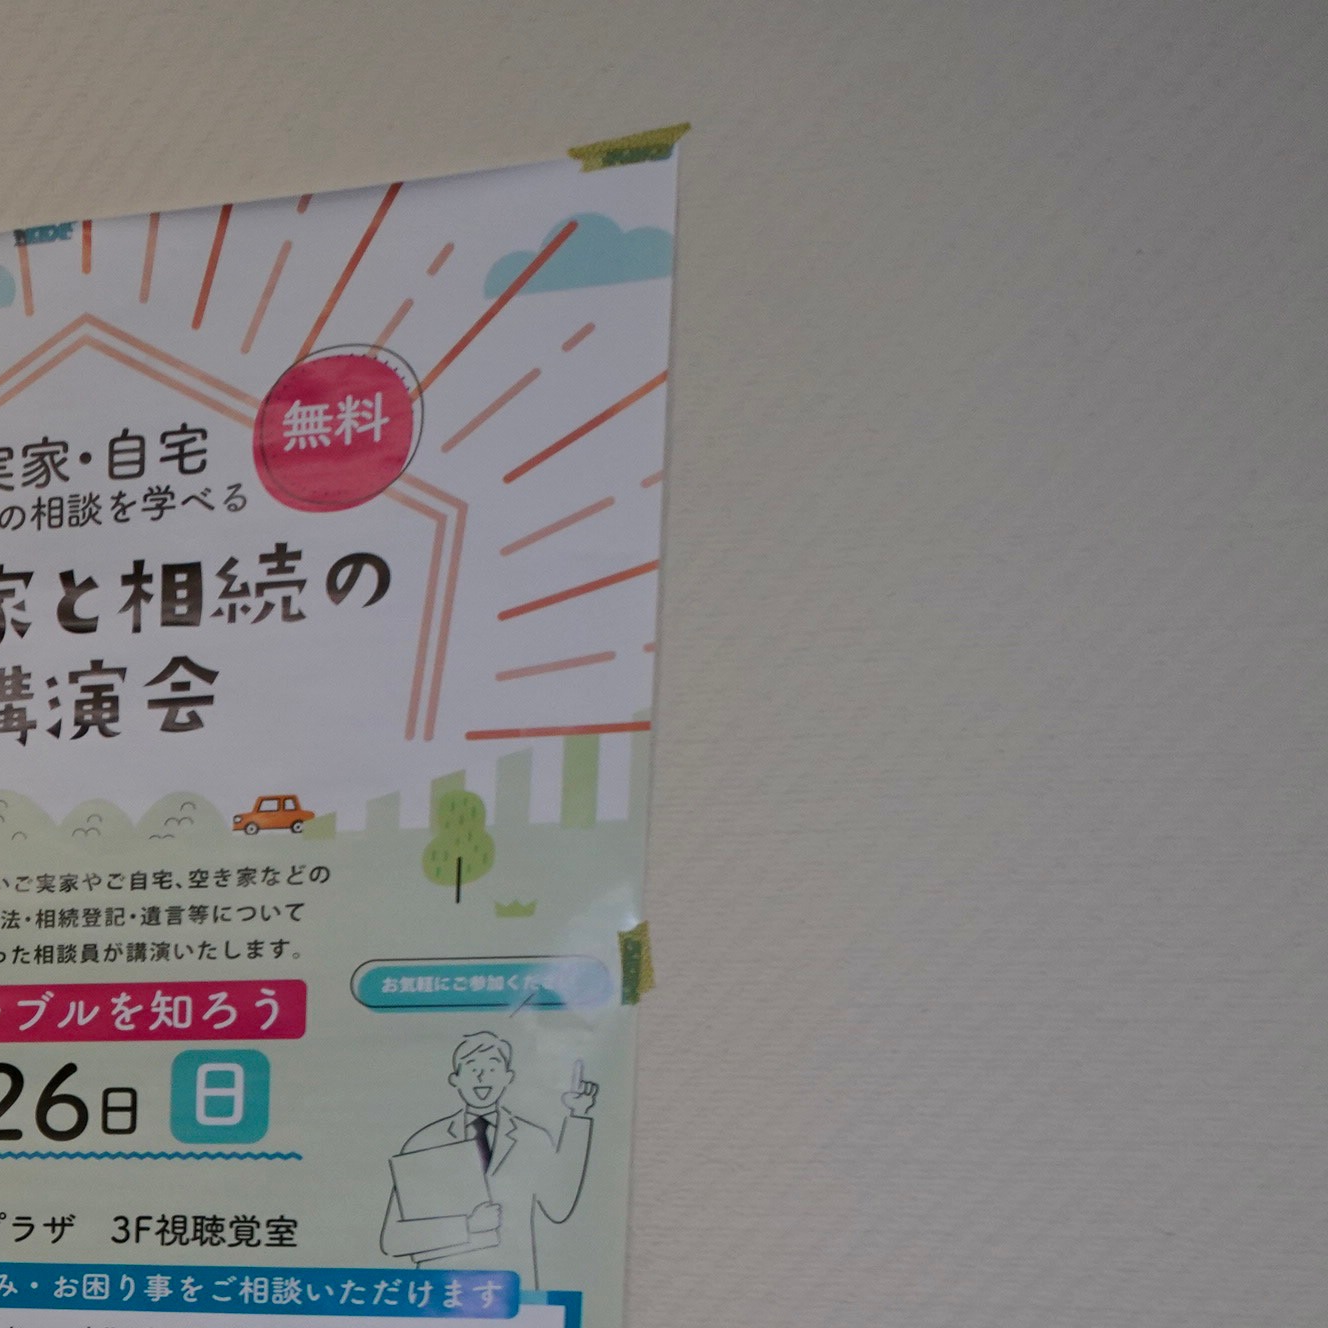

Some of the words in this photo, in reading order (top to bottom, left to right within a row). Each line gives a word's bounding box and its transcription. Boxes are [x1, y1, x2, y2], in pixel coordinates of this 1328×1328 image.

[281, 391, 390, 452] 無料
[380, 973, 574, 993] お気軽にご参加くだ
[195, 1062, 245, 1126] 日
[110, 1214, 299, 1248] 3F視聴覚室
